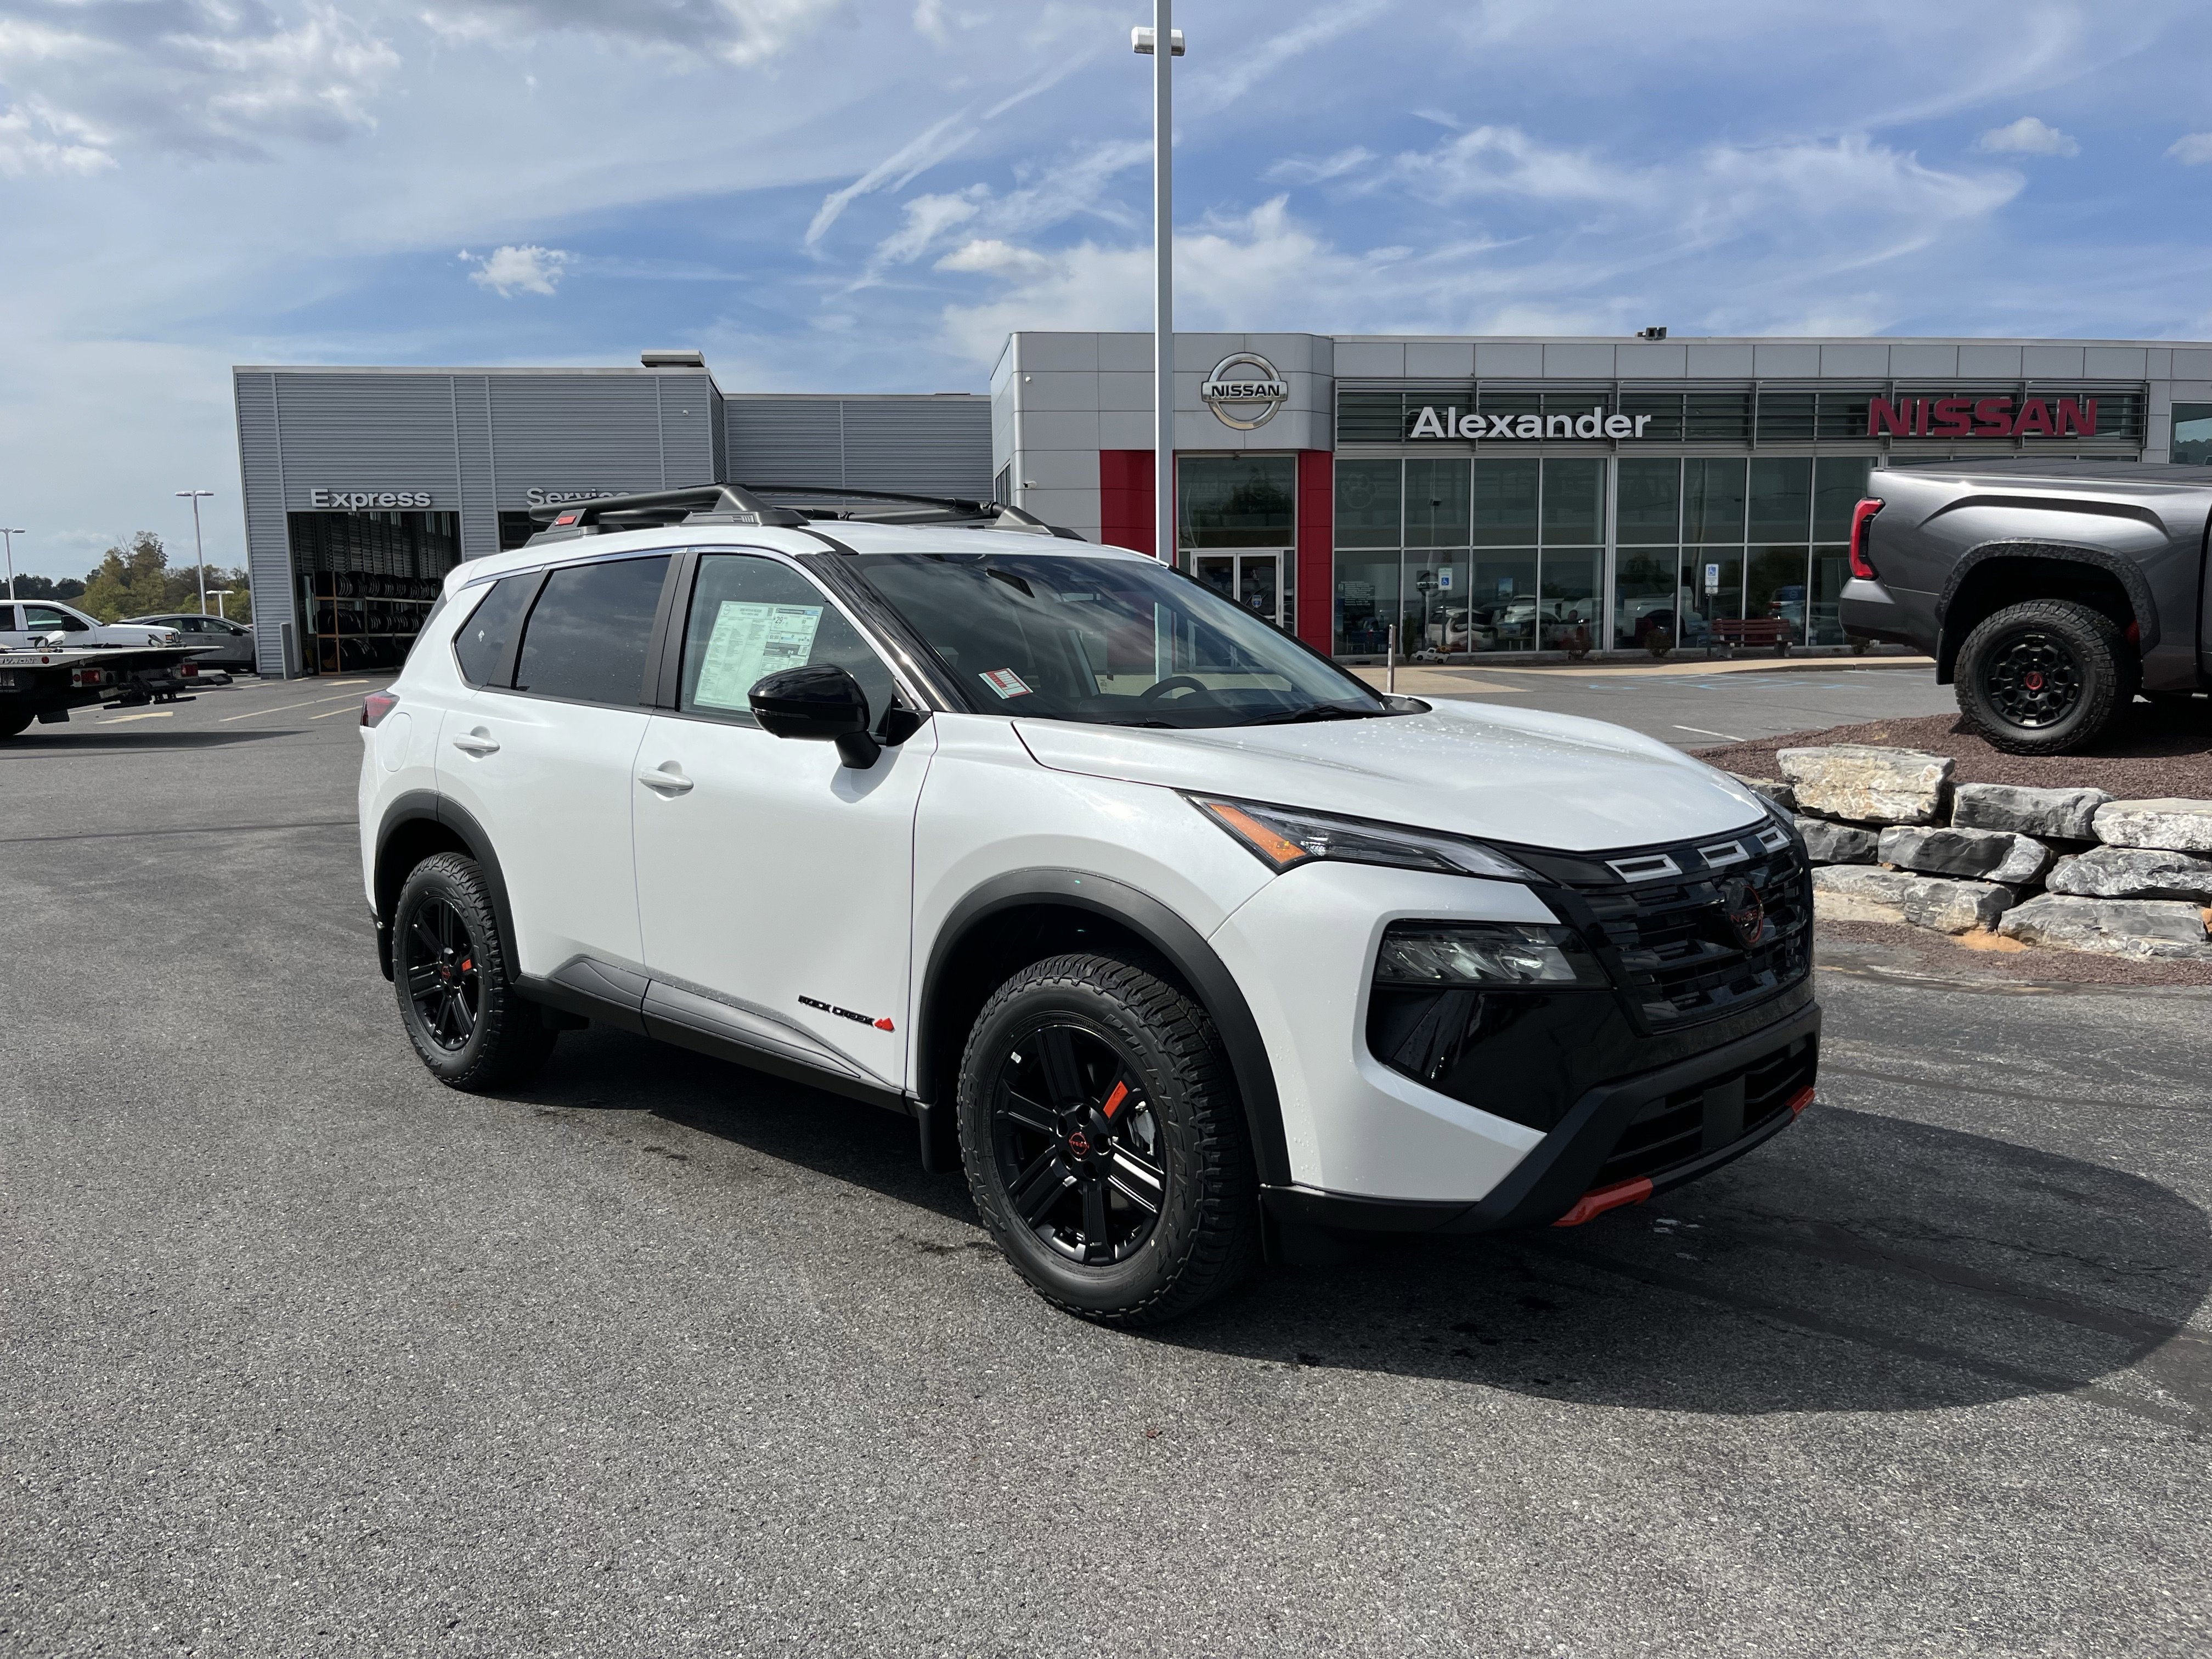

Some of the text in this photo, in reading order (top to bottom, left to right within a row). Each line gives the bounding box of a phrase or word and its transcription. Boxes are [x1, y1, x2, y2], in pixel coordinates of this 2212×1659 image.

[1211, 385, 1280, 397] NISSAN
[1410, 407, 1651, 438] Alexander
[1867, 398, 2097, 437] NISSAN
[310, 488, 431, 511] Express
[526, 487, 630, 506] Servi
